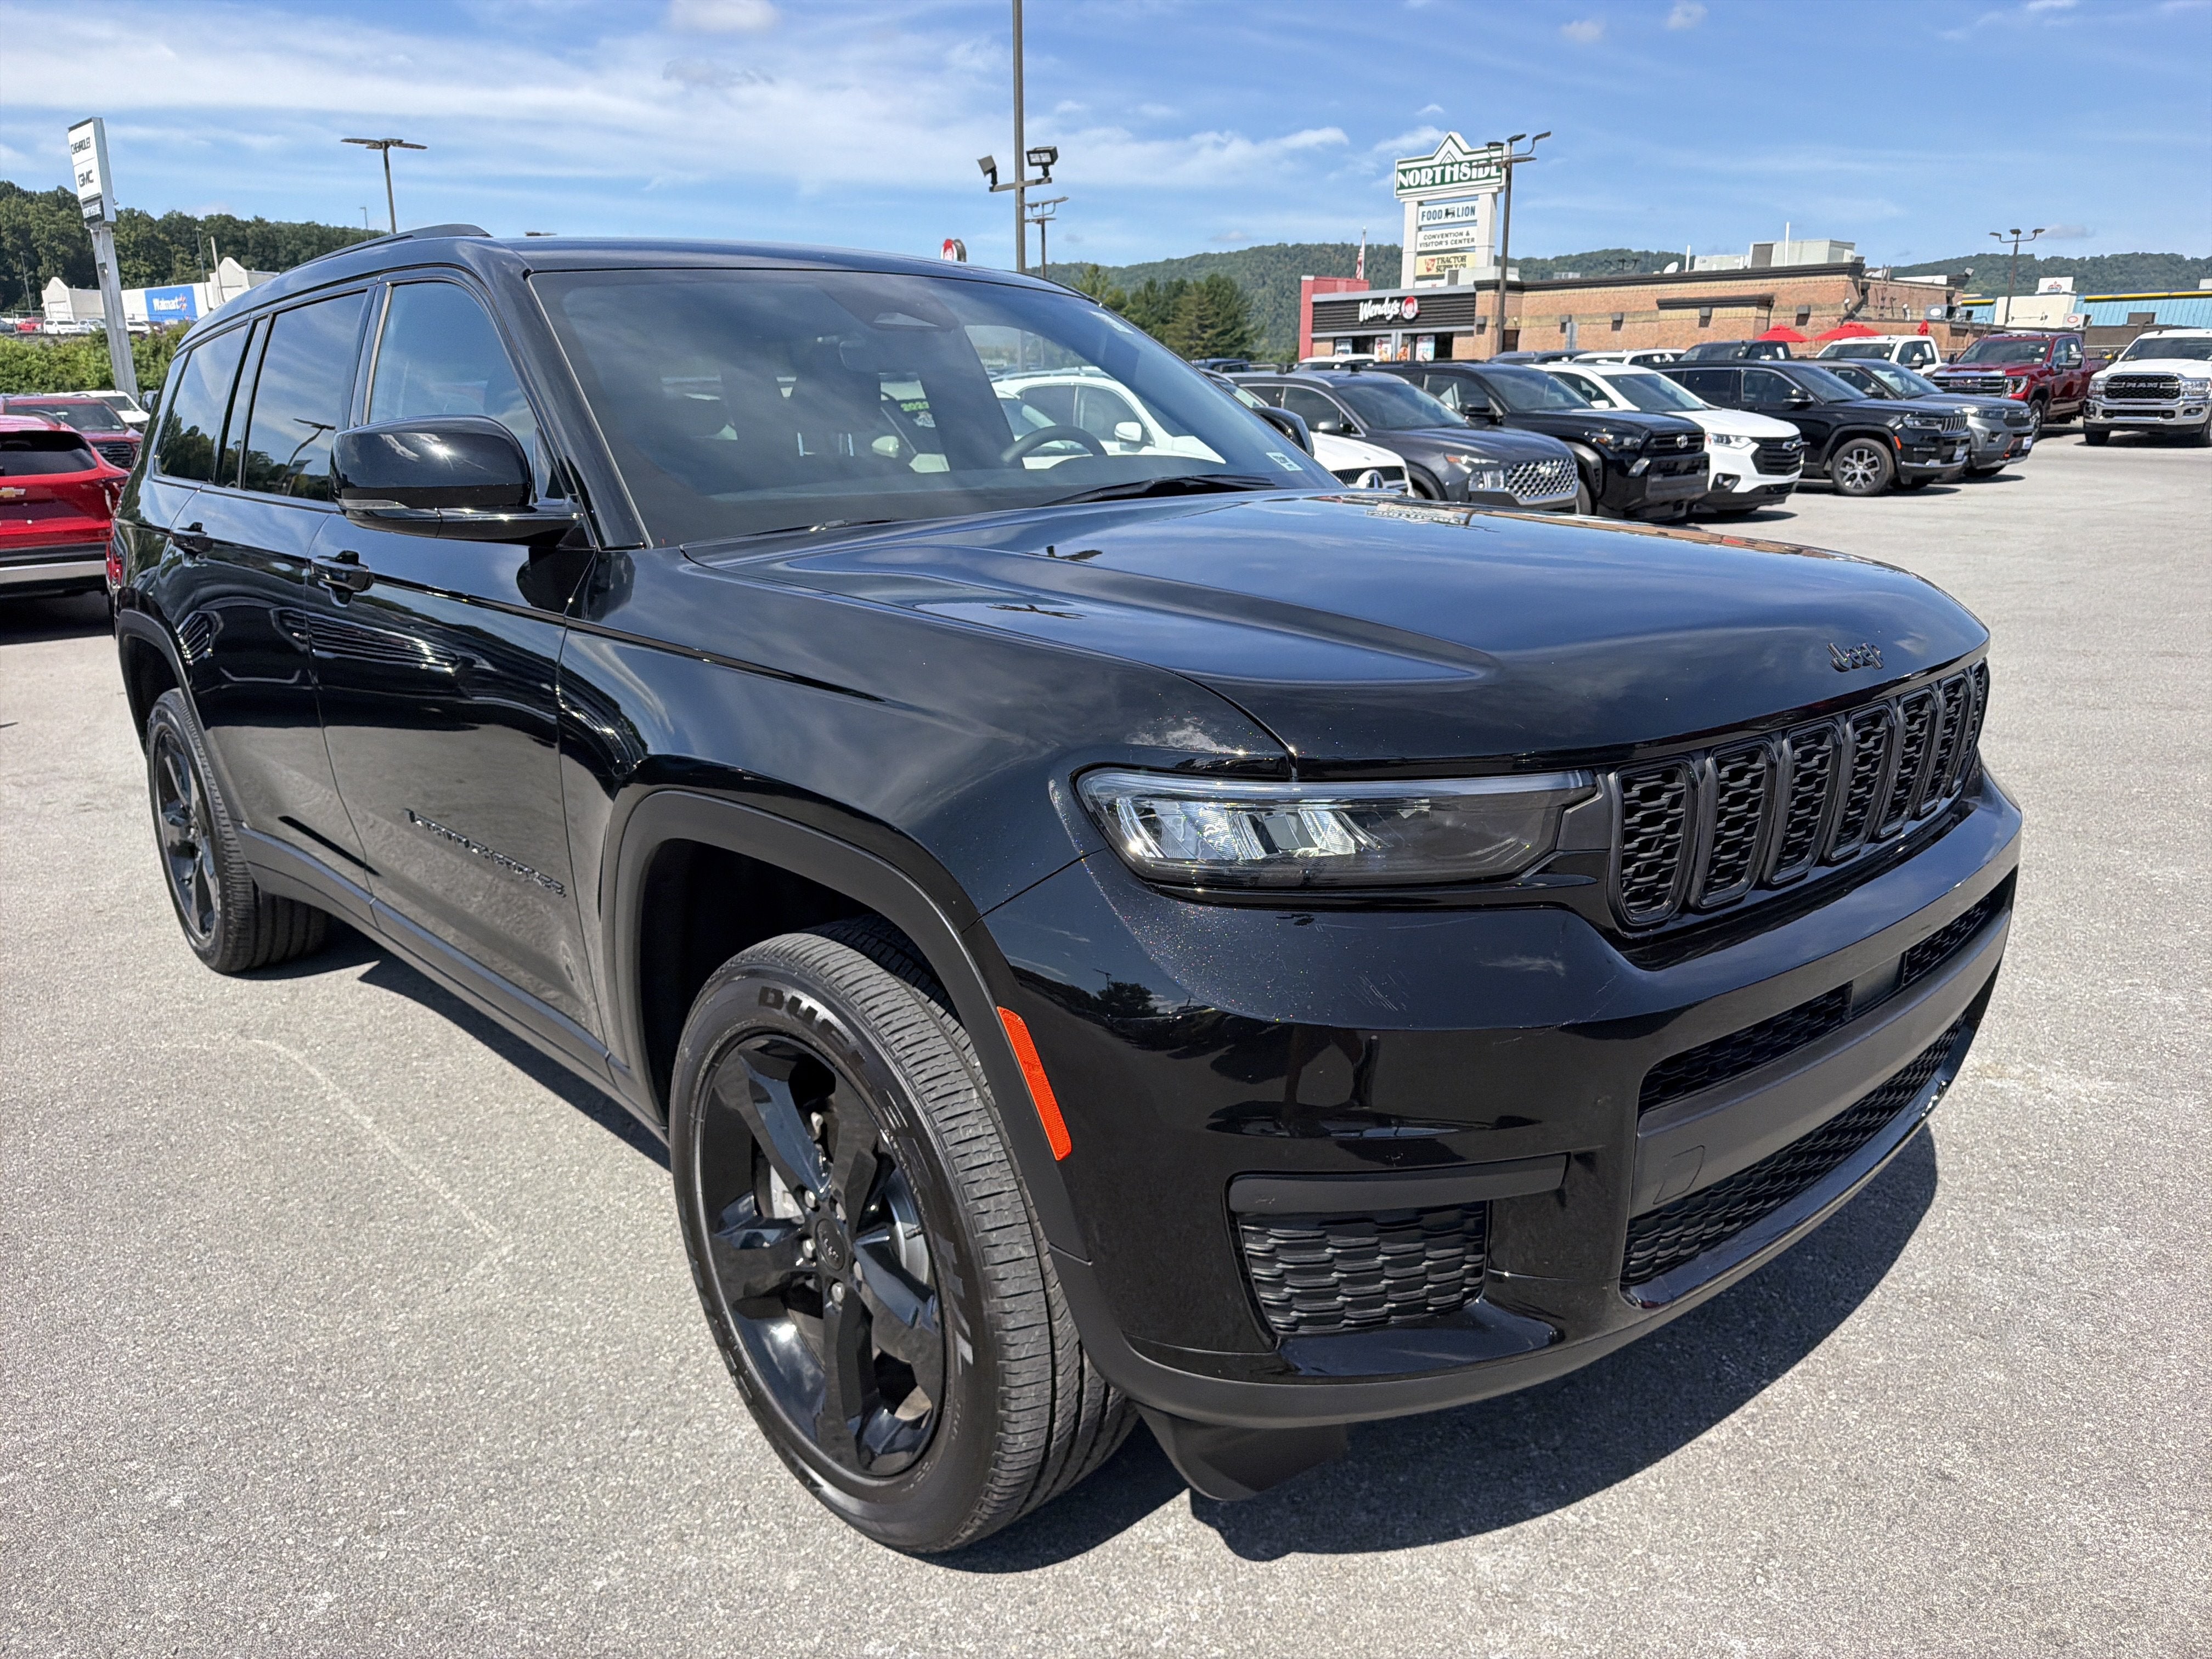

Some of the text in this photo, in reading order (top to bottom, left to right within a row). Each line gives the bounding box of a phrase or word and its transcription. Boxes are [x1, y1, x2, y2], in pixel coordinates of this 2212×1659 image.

[70, 137, 91, 155] CHEVROLET
[78, 169, 94, 188] GMC
[1397, 158, 1502, 188] NORTHSIDE
[1421, 205, 1476, 222] FOOD LION
[1423, 232, 1464, 241] CONVENTION
[1450, 237, 1475, 245] CENTER
[1436, 255, 1467, 264] TRACTOR
[153, 296, 179, 312] Walmart
[1359, 296, 1401, 322] Wendy's
[1826, 642, 1885, 673] Jeep
